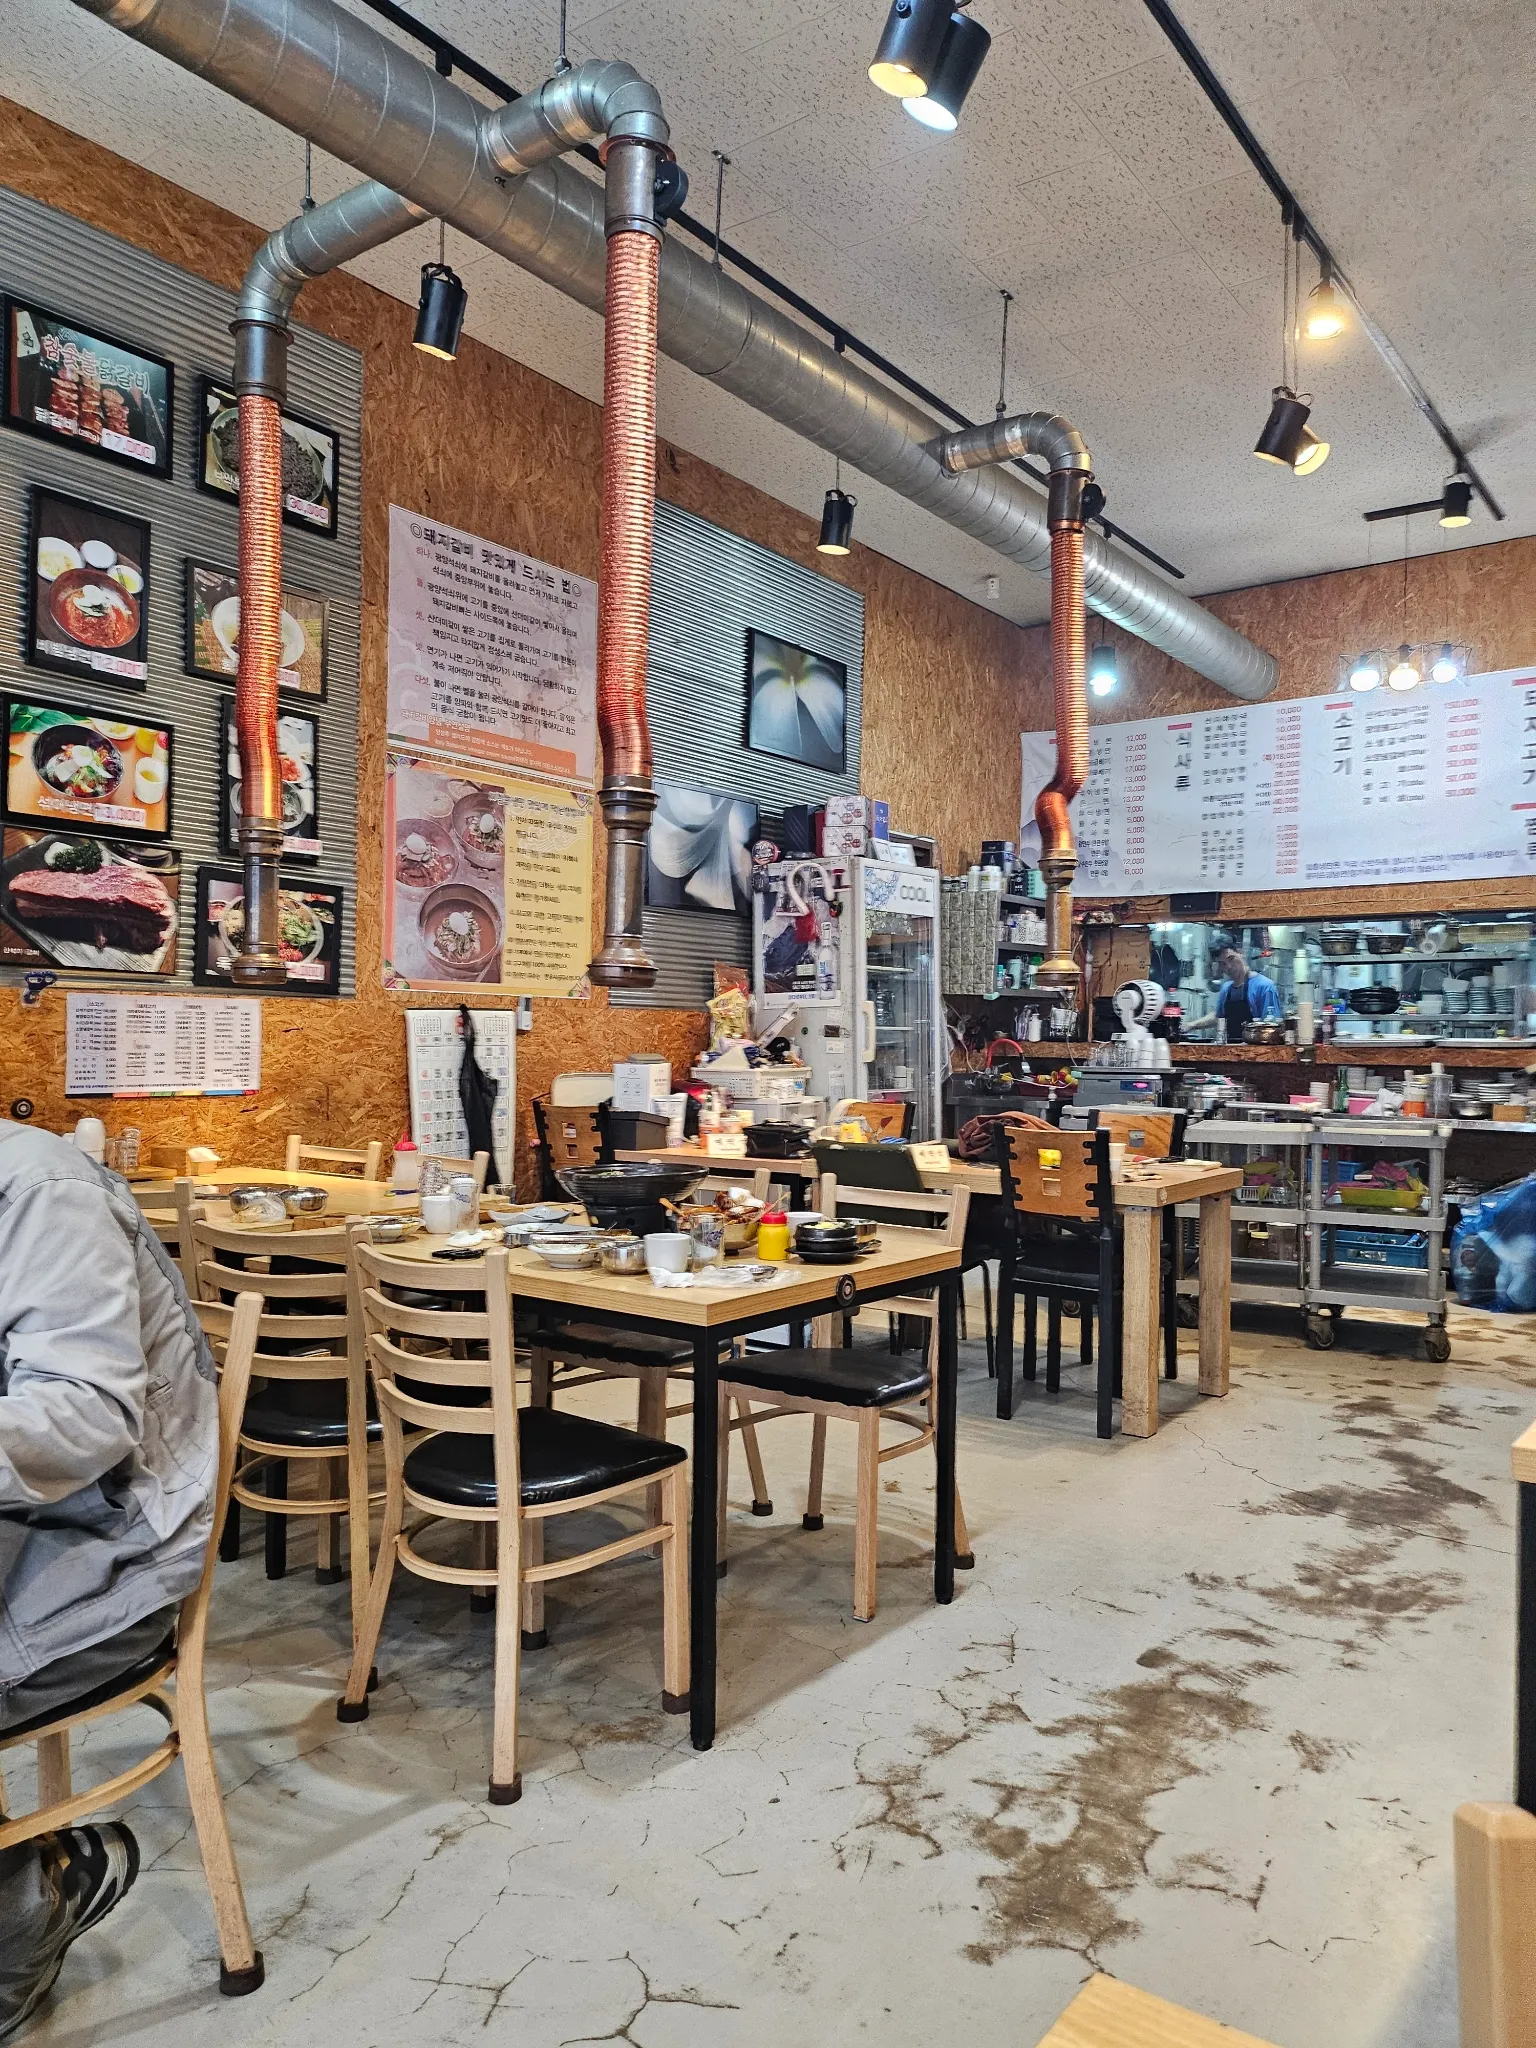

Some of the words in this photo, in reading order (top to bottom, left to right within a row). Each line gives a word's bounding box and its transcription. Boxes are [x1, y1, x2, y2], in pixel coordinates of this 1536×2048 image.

[416, 547, 432, 559] 하나.
[470, 566, 500, 583] 돼지갈비를
[424, 528, 473, 559] 돼지갈비
[482, 549, 515, 574] 맛있게
[523, 565, 555, 588] 드시는
[562, 579, 570, 594] 법
[455, 573, 485, 591] 중앙부위에
[470, 597, 488, 609] 고기를
[427, 614, 460, 631] 산더미같이
[477, 630, 496, 642] 고기를
[433, 629, 460, 643] 책임지고
[427, 646, 447, 659] 연기가
[450, 653, 463, 663] 나면
[465, 657, 484, 669] 고기가
[1332, 712, 1354, 776] 소고기
[900, 885, 930, 903] COOL
